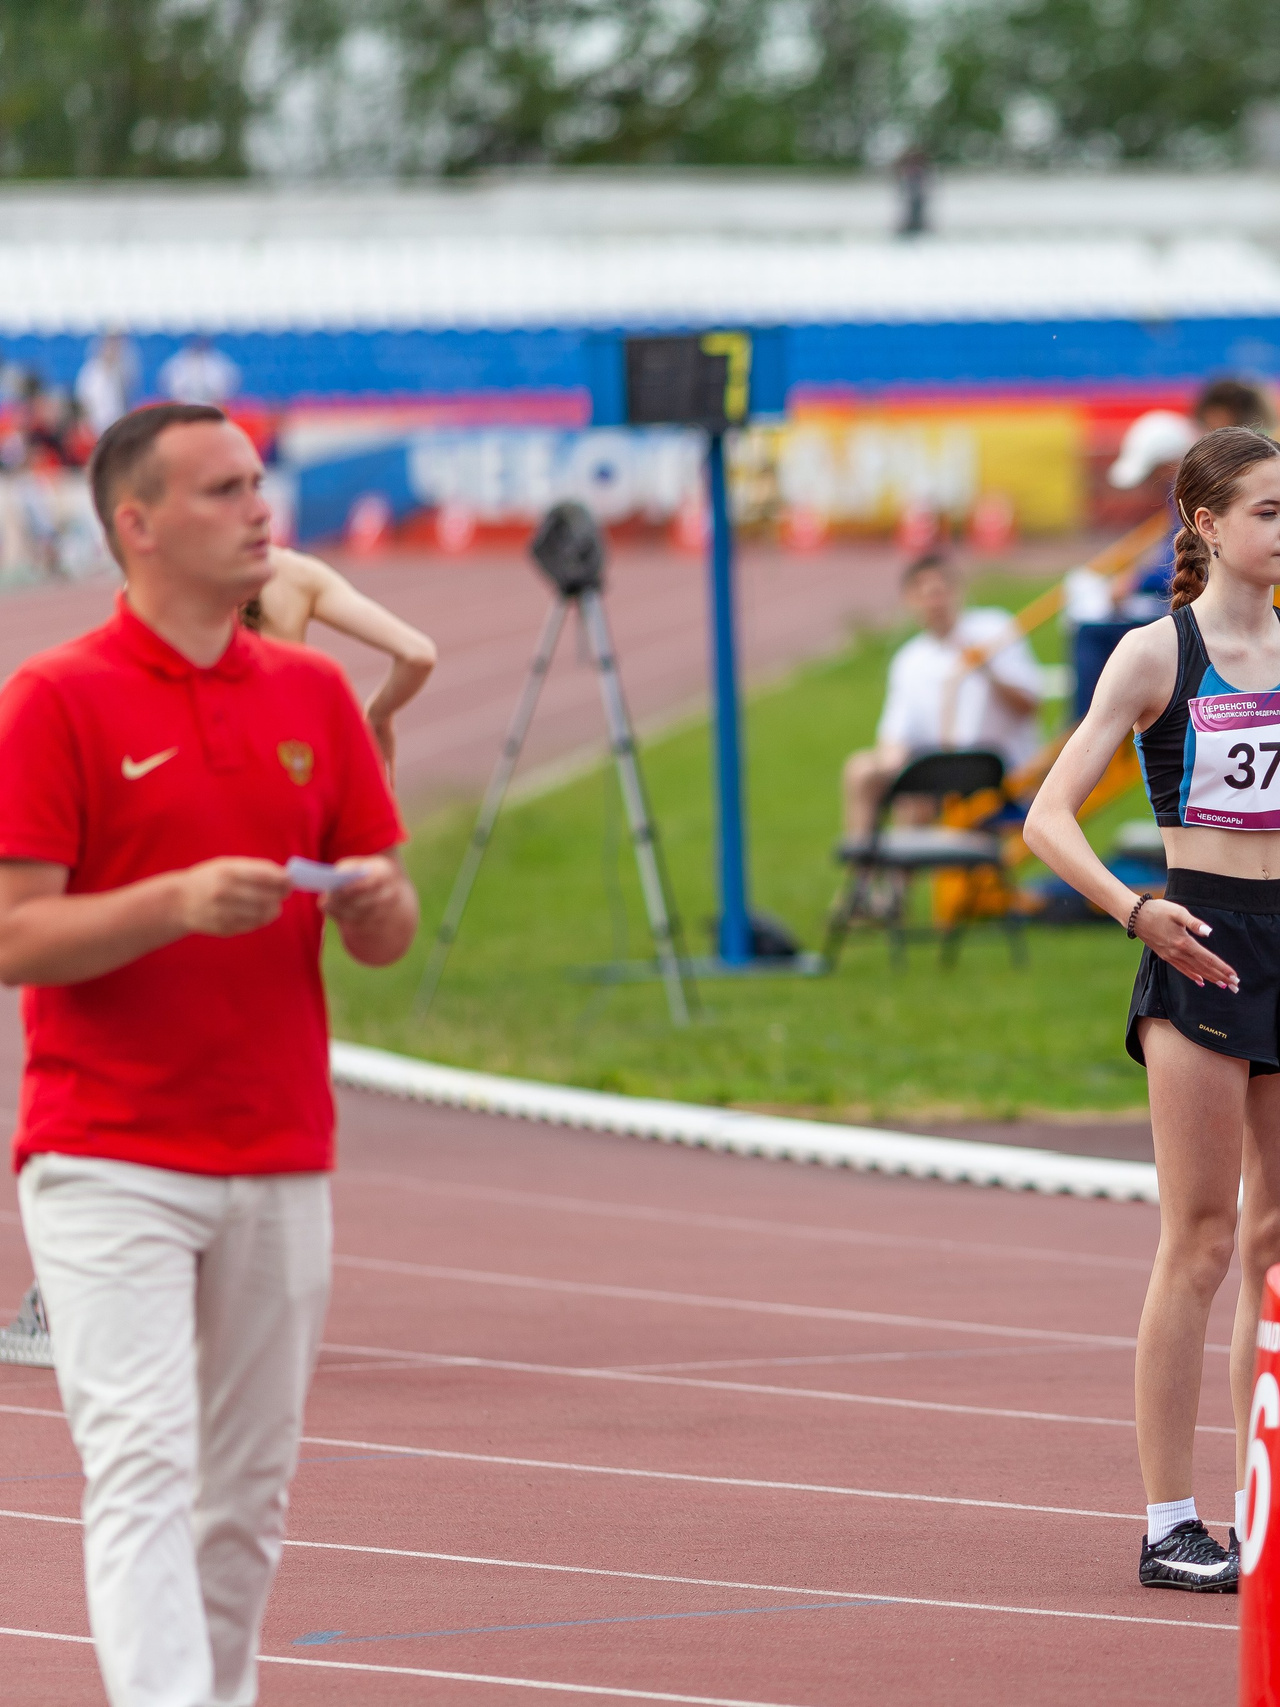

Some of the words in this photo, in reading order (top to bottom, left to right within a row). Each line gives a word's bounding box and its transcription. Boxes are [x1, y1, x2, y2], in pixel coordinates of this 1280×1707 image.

[700, 332, 752, 423] 7
[1202, 701, 1257, 714] ПЕРВЕНСТВО
[1197, 812, 1243, 825] ЧЕБОКСАРЫ
[1198, 1023, 1228, 1039] DIAMATTI
[1240, 1372, 1280, 1576] 6
